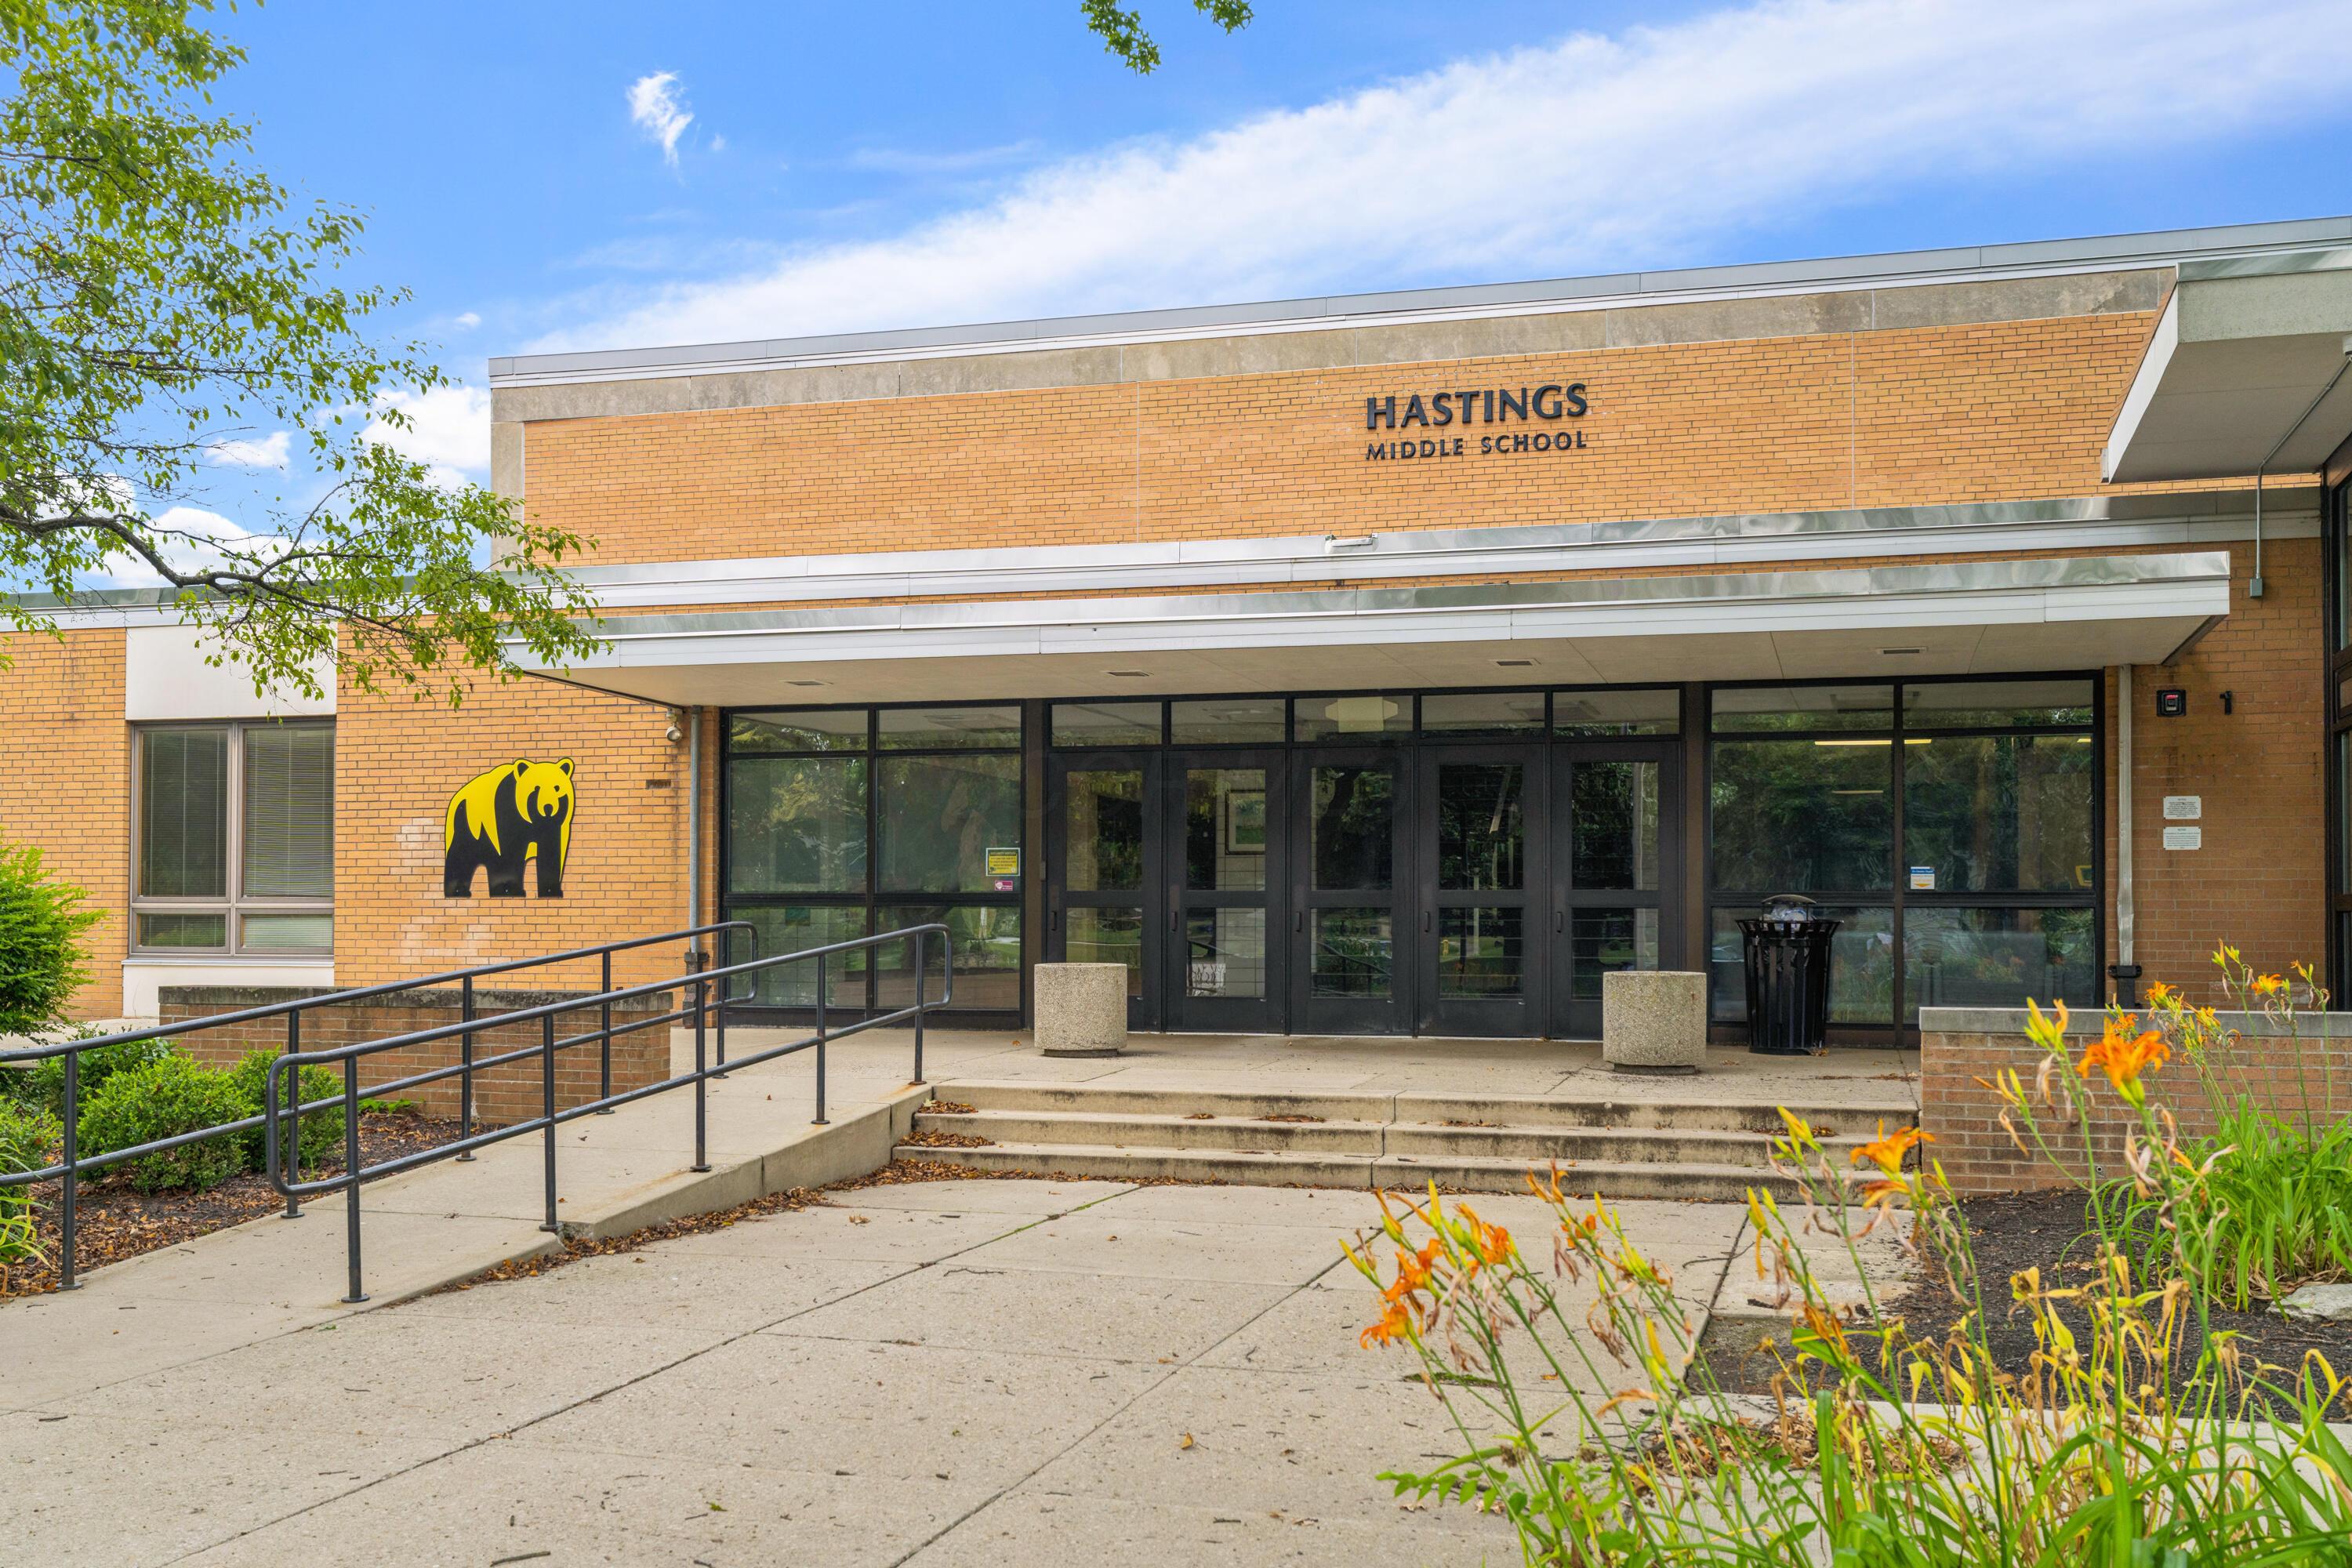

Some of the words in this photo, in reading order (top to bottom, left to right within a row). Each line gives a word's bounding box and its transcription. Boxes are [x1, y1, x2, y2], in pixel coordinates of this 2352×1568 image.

[1367, 383, 1588, 430] HASTINGS
[1366, 437, 1464, 460] MIDDLE
[1481, 430, 1587, 453] SCHOOL
